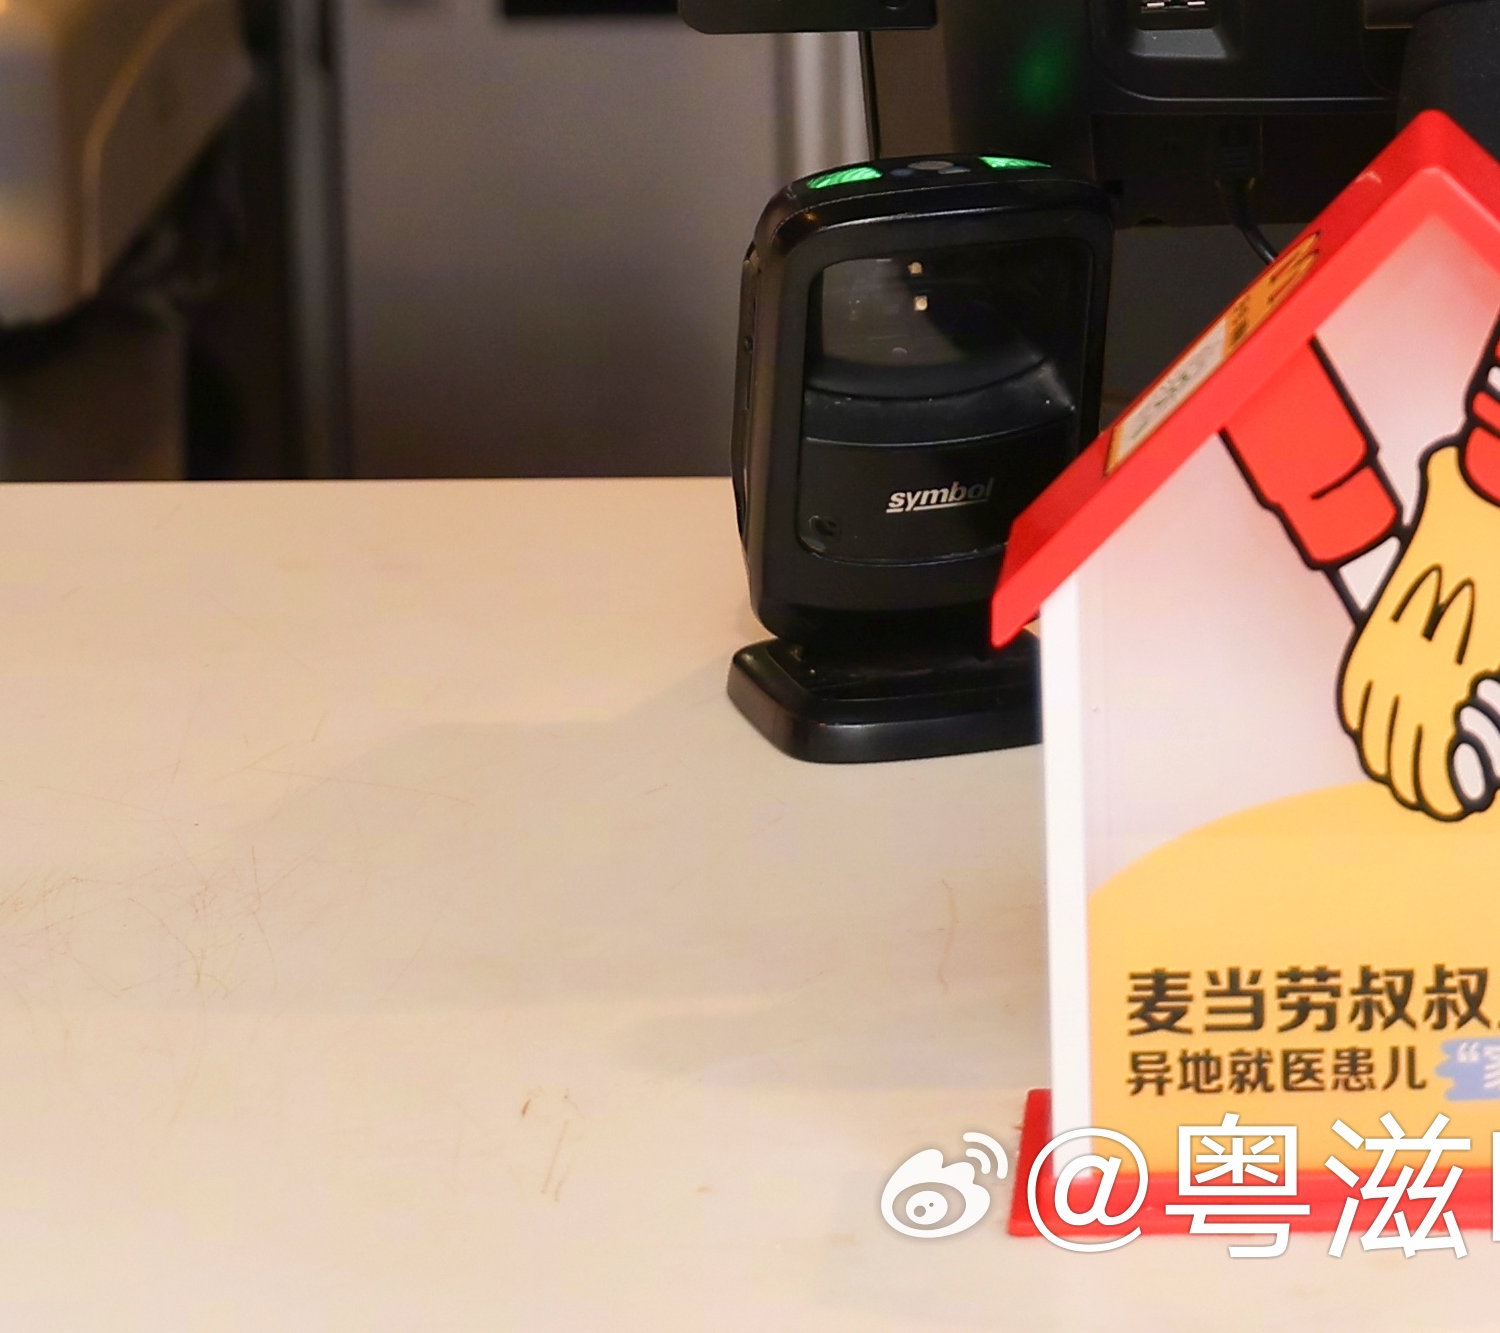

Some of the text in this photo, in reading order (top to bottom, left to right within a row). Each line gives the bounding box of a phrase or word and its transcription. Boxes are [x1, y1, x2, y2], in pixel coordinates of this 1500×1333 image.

[886, 476, 995, 513] symbol
[1126, 1044, 1428, 1097] 异地就医患儿
